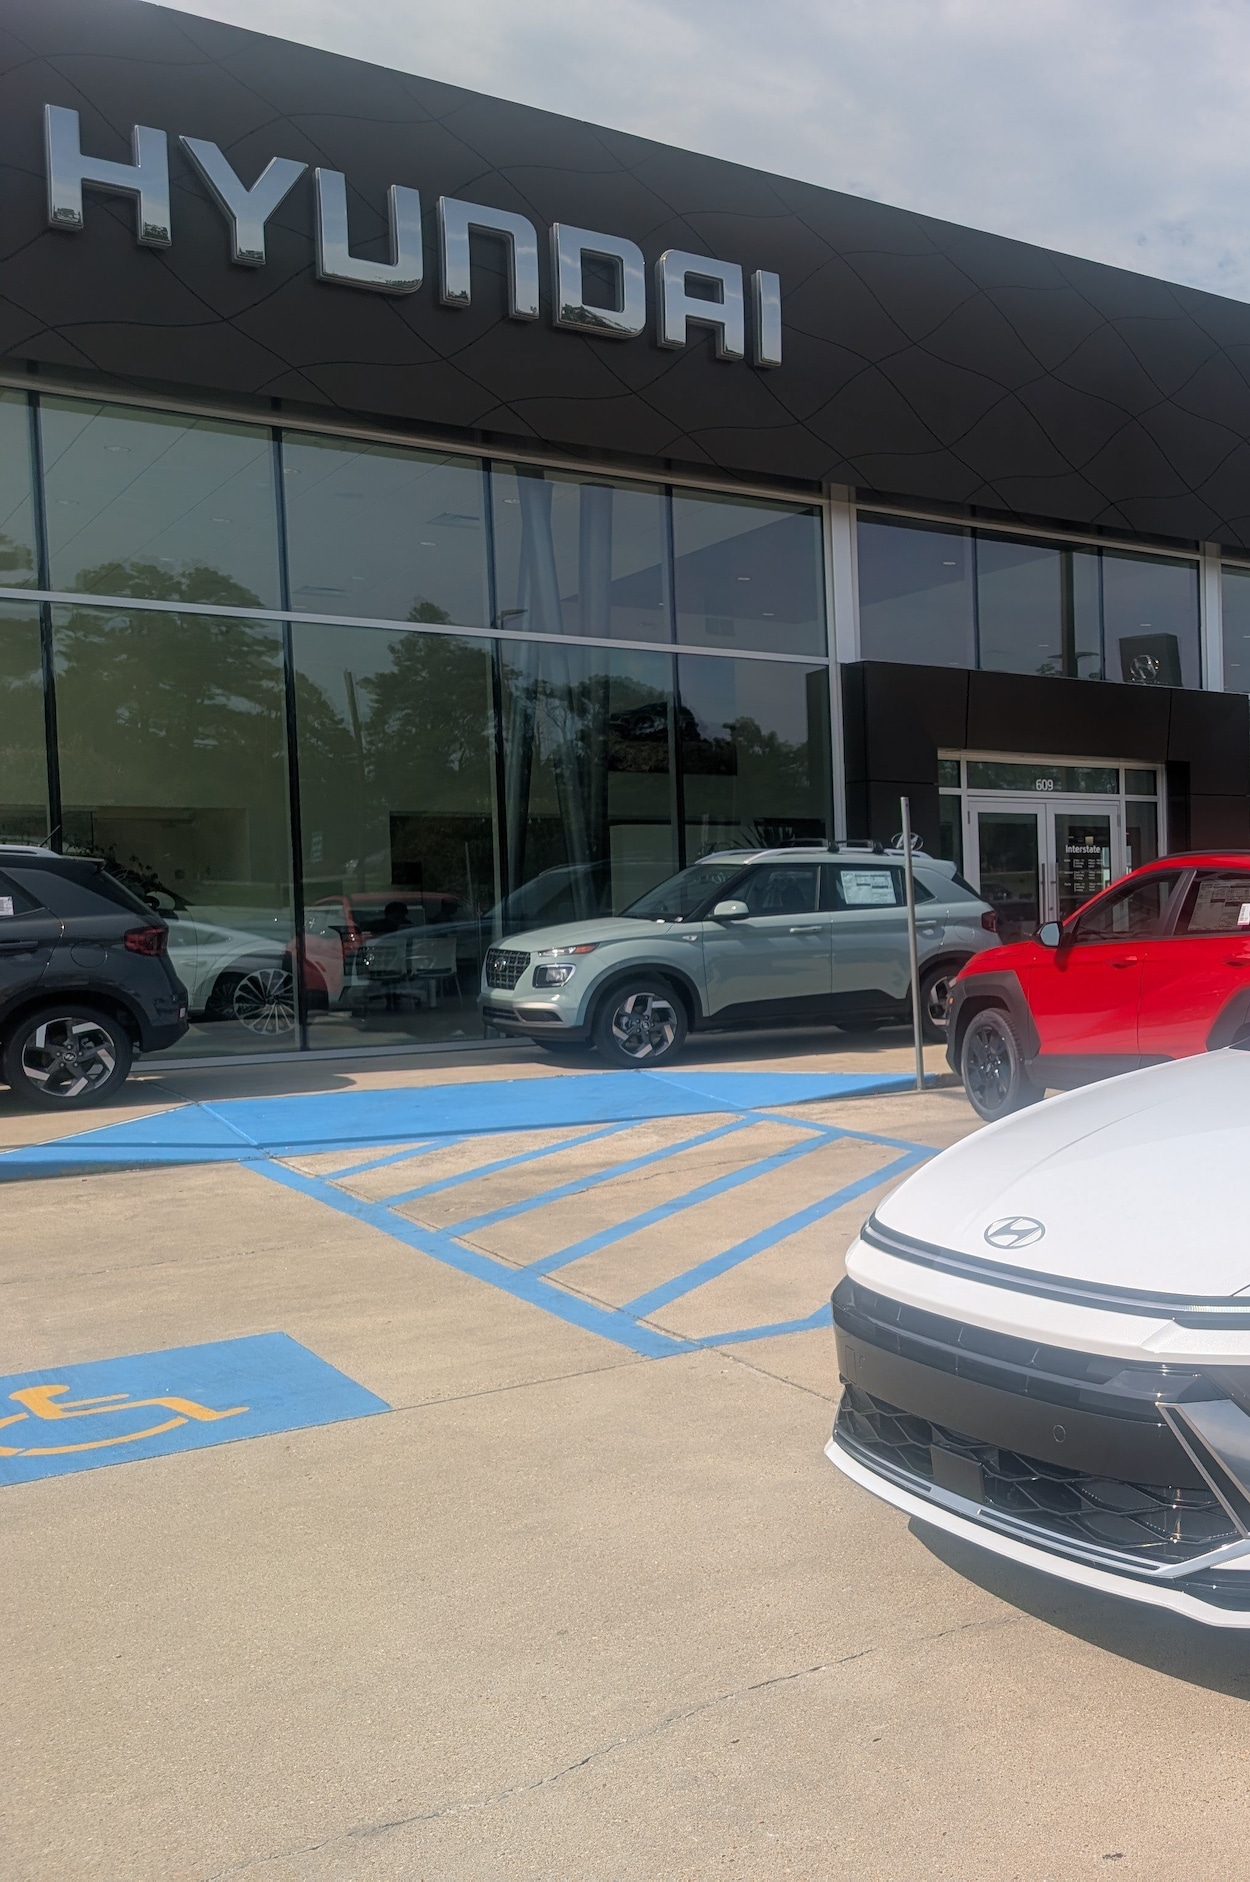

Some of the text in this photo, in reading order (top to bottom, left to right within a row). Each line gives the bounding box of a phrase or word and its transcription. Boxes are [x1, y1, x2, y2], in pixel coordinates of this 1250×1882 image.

[44, 103, 783, 368] HYUNDAI
[1035, 779, 1054, 791] 609
[1065, 844, 1101, 854] Interstate
